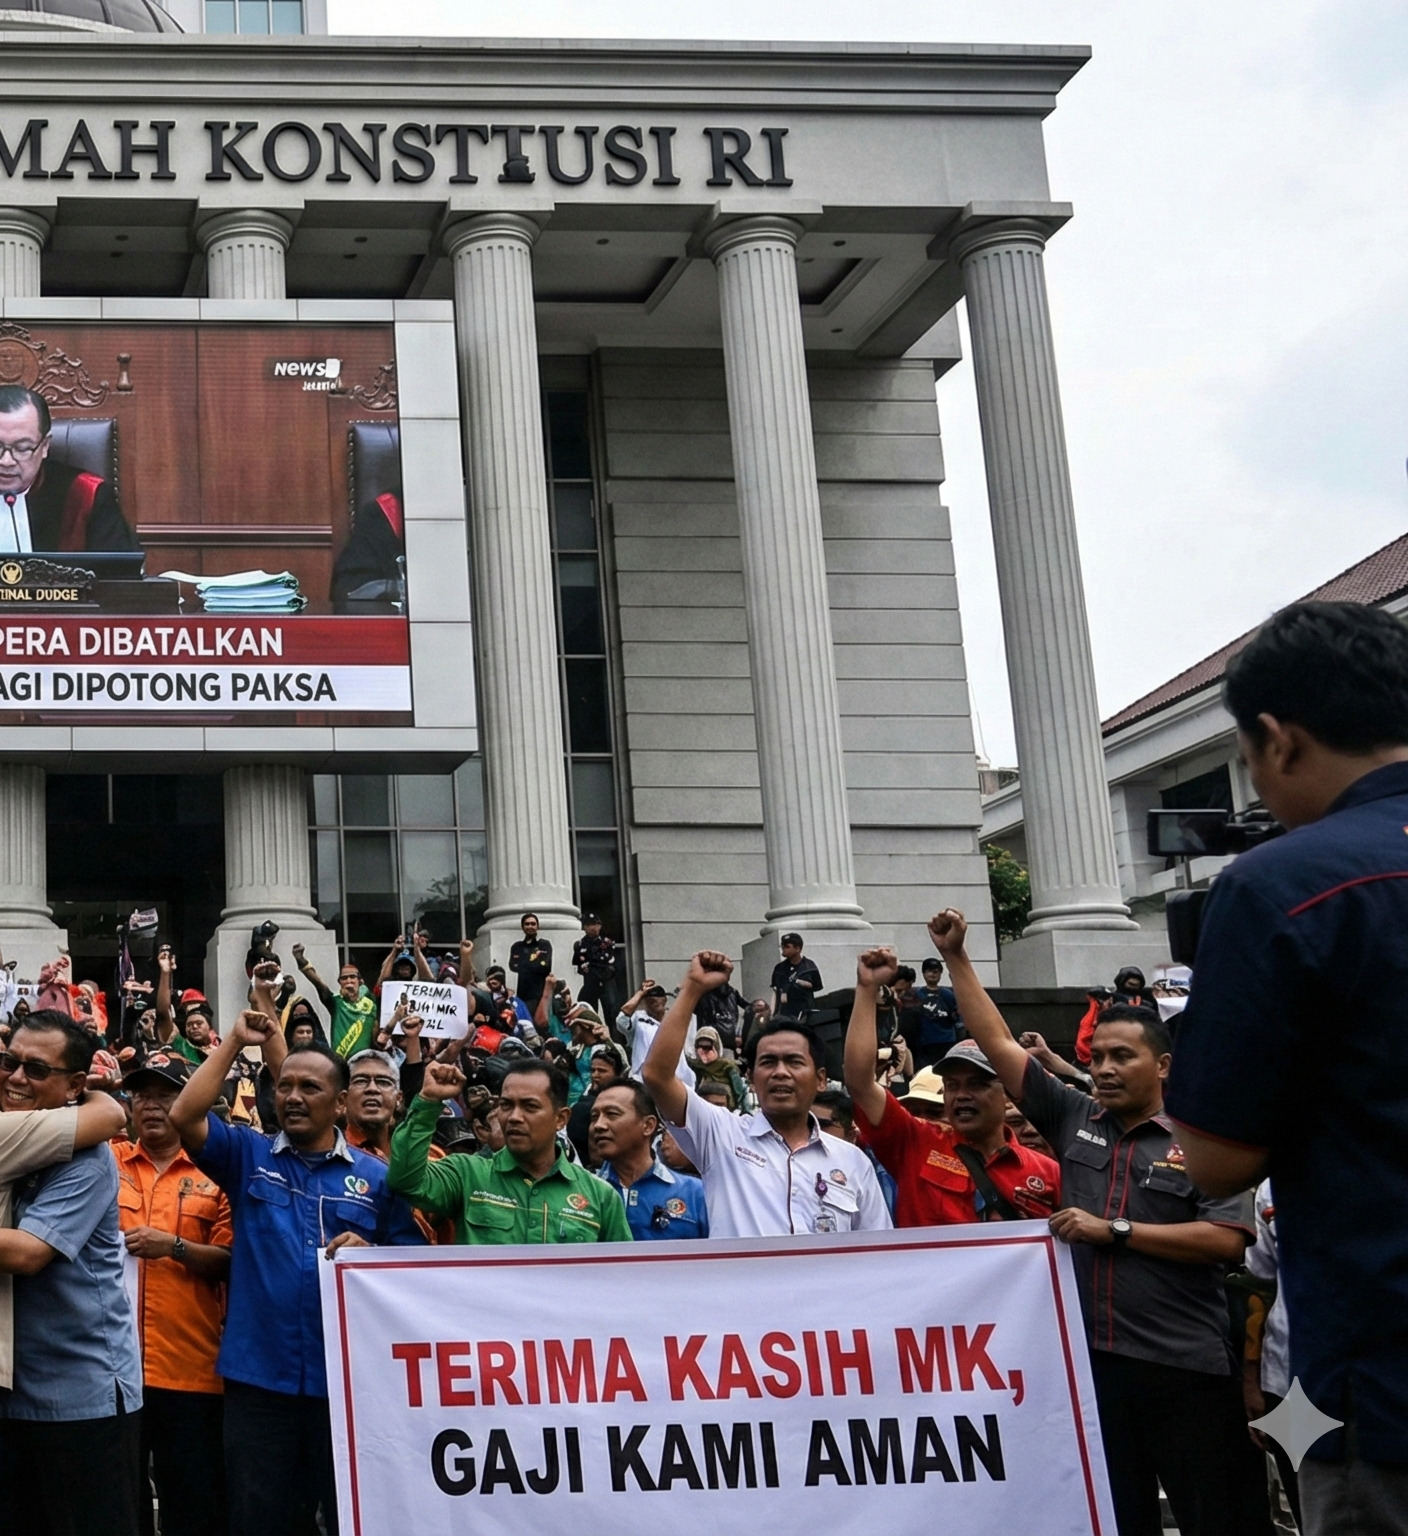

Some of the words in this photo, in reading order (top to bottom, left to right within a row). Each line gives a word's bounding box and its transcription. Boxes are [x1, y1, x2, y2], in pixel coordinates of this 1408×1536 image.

[703, 126, 794, 187] RI
[79, 627, 283, 657] DIBATALKAN
[52, 672, 221, 702] DIPOTONG
[231, 673, 337, 702] PAKSA
[393, 1337, 647, 1407] TERIMA
[664, 1329, 875, 1400] KASIH
[895, 1323, 1025, 1407] MK,
[431, 1427, 584, 1496] GAJI
[606, 1421, 780, 1492] KAMI
[804, 1414, 1006, 1487] AMAN
